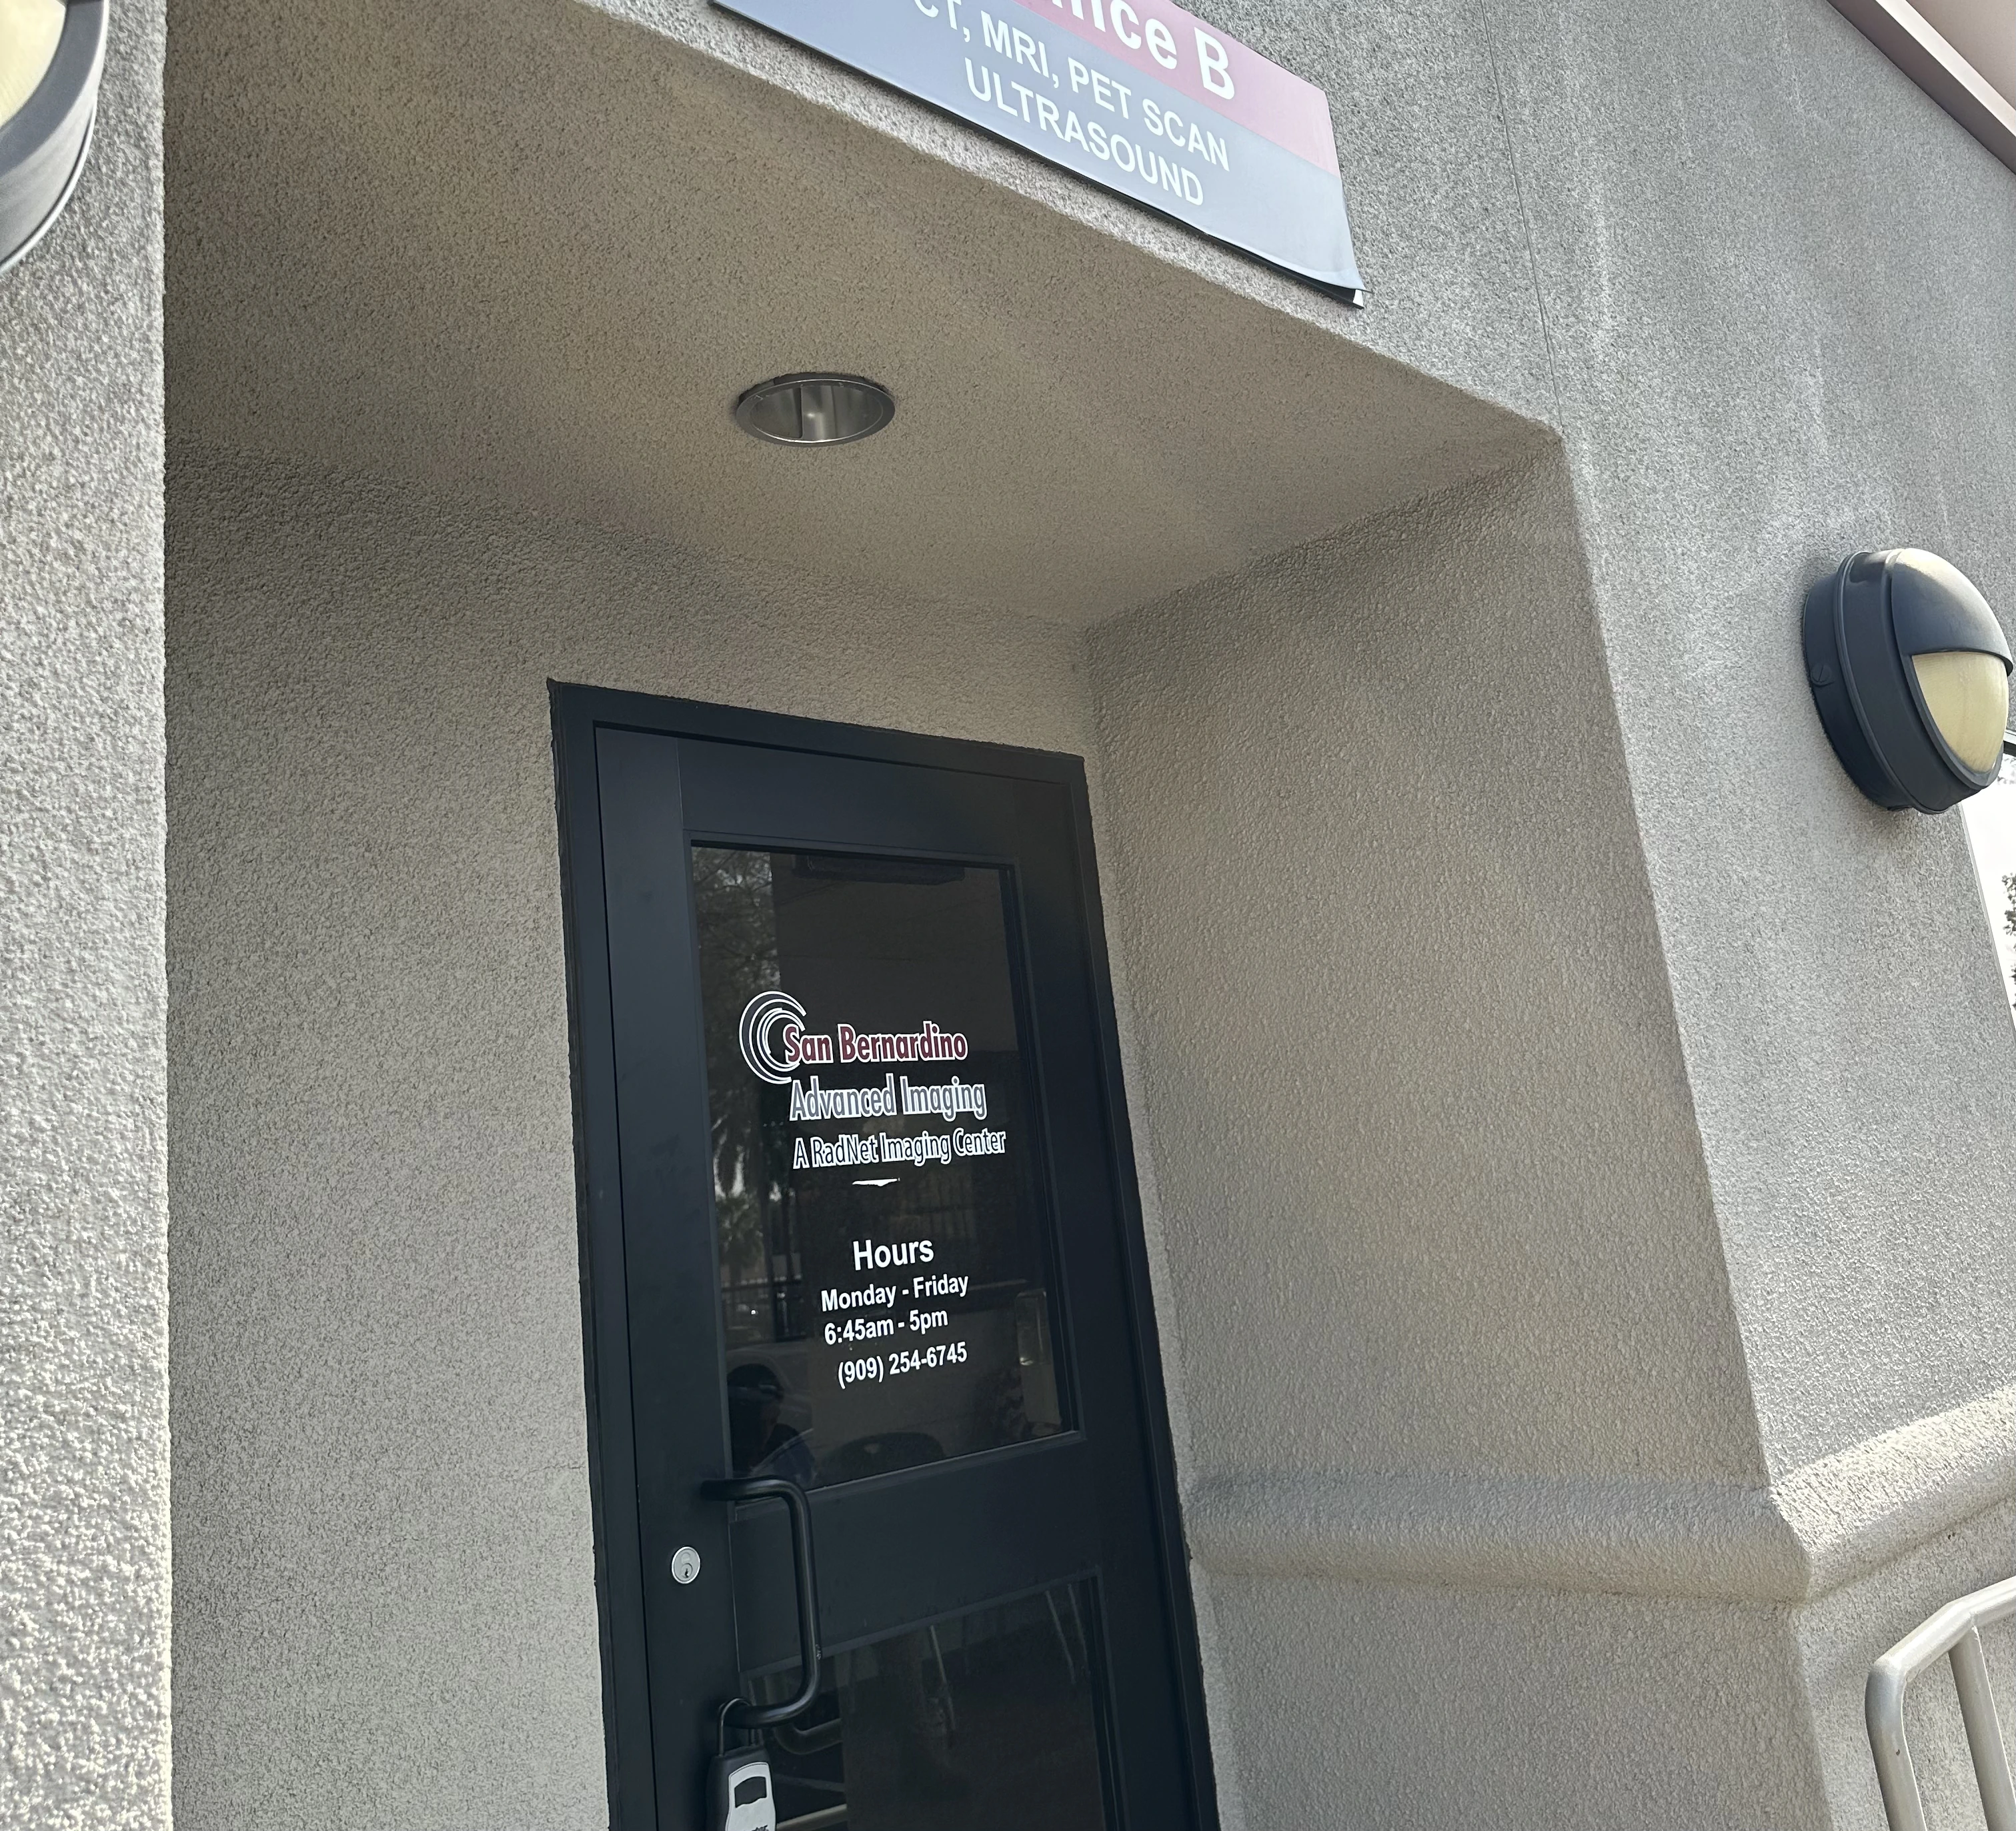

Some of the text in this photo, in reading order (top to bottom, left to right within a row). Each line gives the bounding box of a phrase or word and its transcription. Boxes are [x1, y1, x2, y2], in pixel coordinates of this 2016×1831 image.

[1194, 27, 1235, 100] B
[981, 11, 1059, 89] MRI,
[1068, 57, 1132, 119] PET
[1142, 99, 1230, 171] SCAN
[965, 57, 1204, 205] ULTRASOUND
[783, 1021, 968, 1064] San Bernardino
[790, 1073, 987, 1122] Advanced Imaging
[793, 1128, 1006, 1170] A RadNet Imaging Center
[853, 1240, 934, 1270] Hours
[821, 1284, 897, 1312] Monday
[913, 1274, 969, 1298] Friday
[824, 1319, 894, 1345] 6:45am
[909, 1310, 948, 1334] 5pm
[838, 1342, 968, 1389] (909) 254-6745
